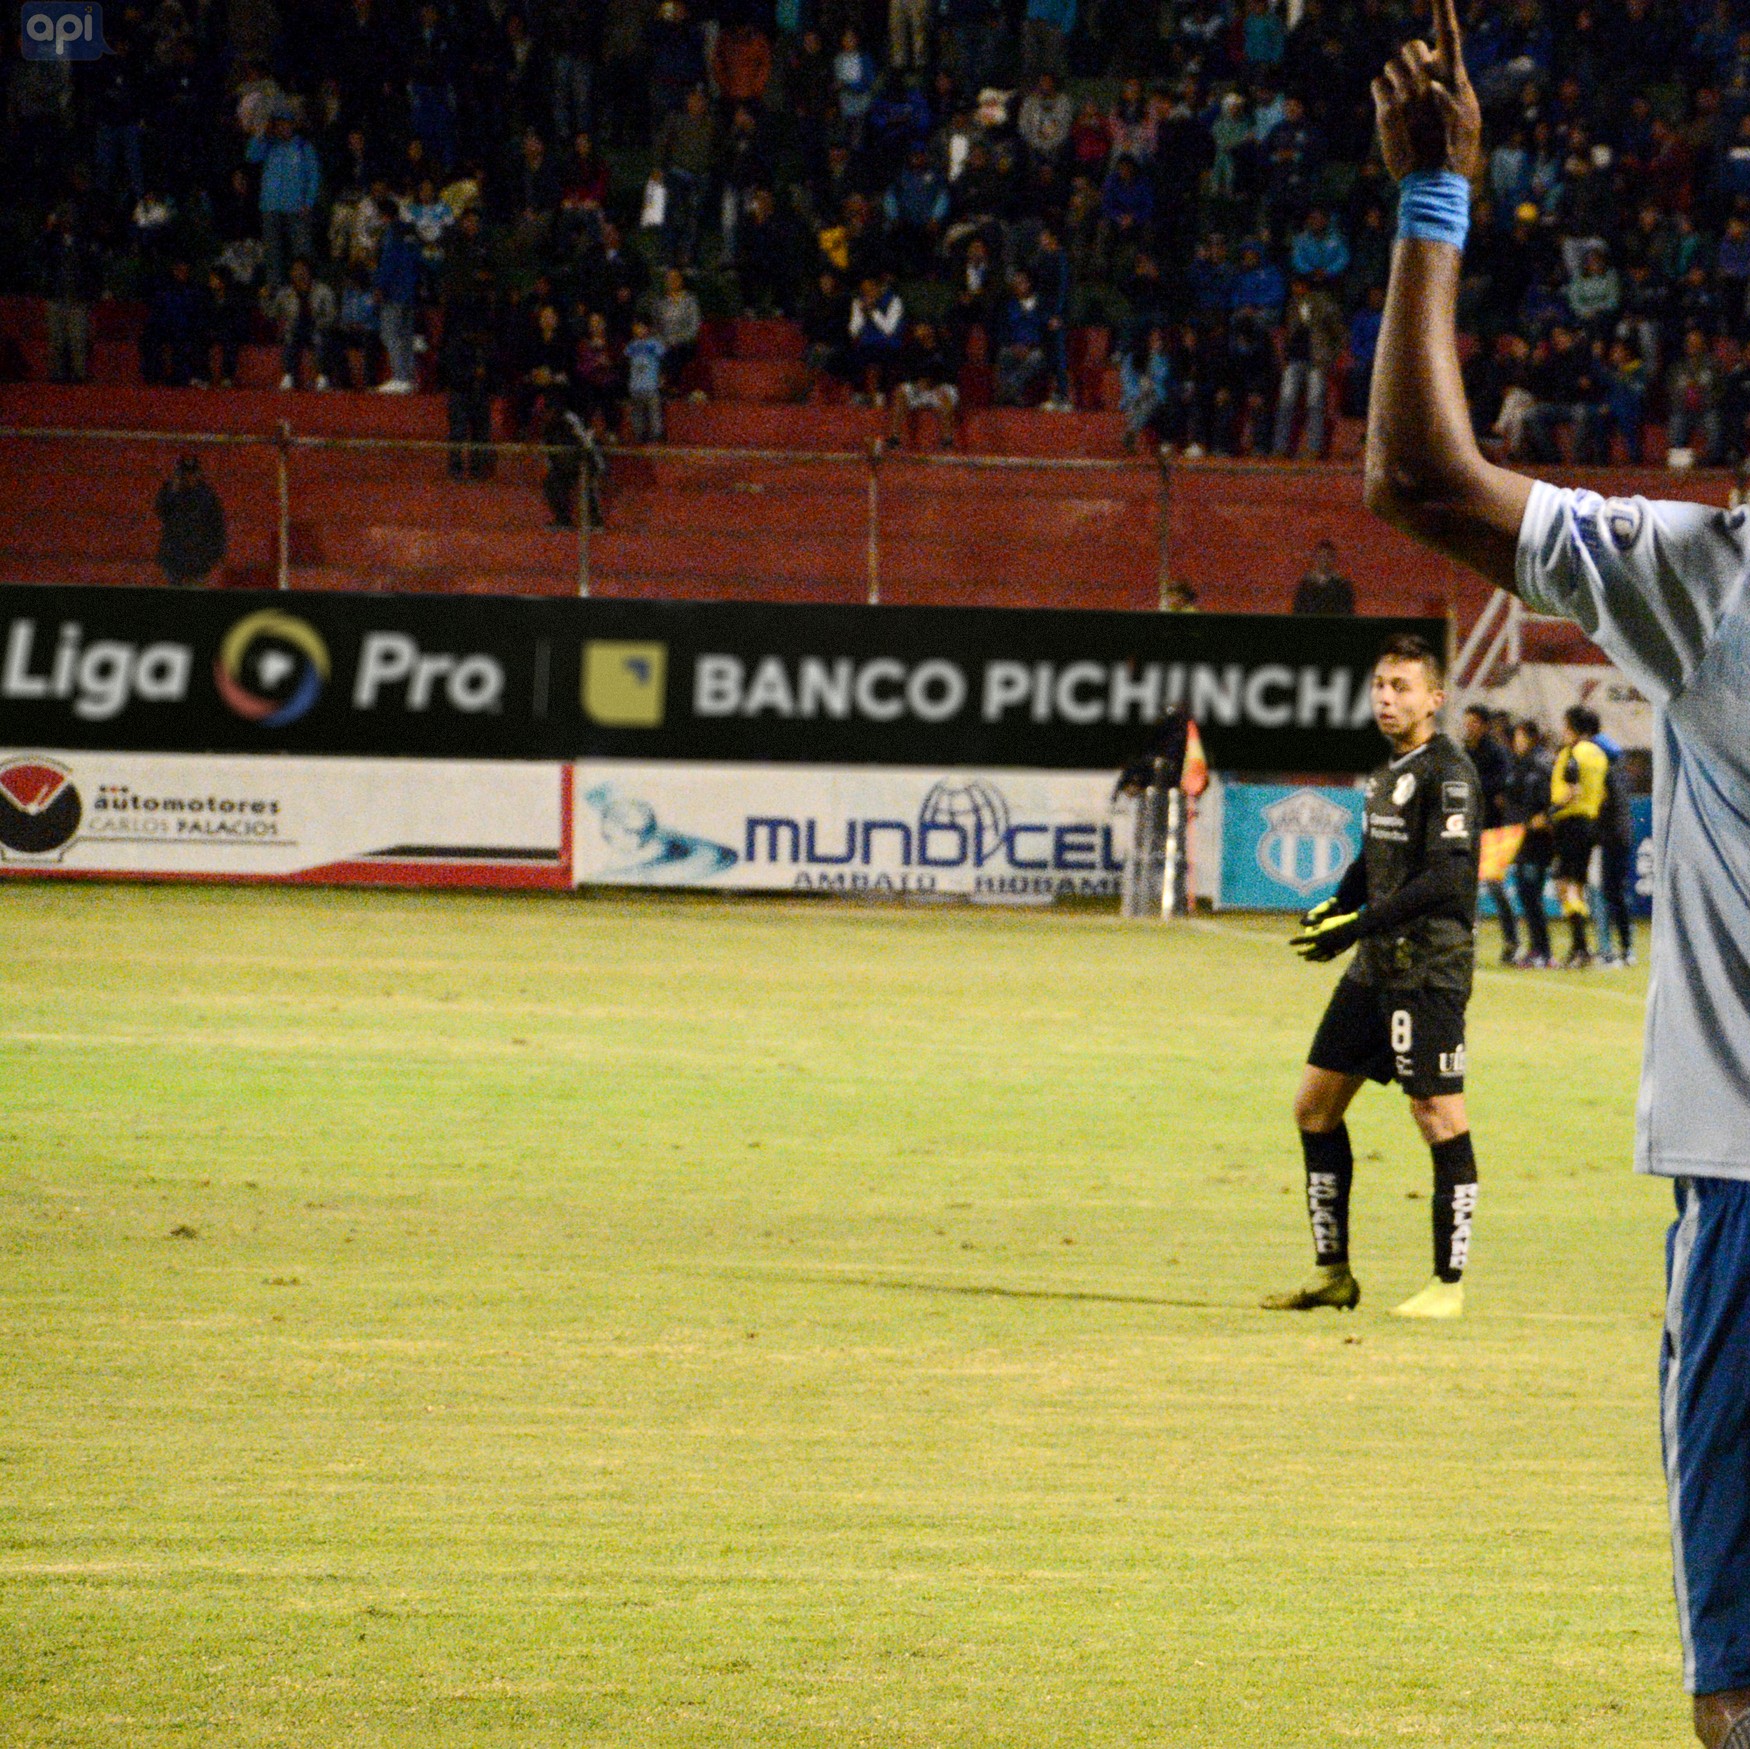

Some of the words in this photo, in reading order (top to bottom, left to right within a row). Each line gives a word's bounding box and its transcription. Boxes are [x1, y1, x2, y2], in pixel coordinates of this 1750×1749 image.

[2, 618, 193, 722] Liga
[351, 630, 504, 712] Pro
[693, 653, 968, 723] BANCO
[94, 793, 281, 815] automotores
[177, 819, 278, 836] PALACIOS
[794, 871, 935, 890] AMBATO
[1391, 1010, 1412, 1053] 8
